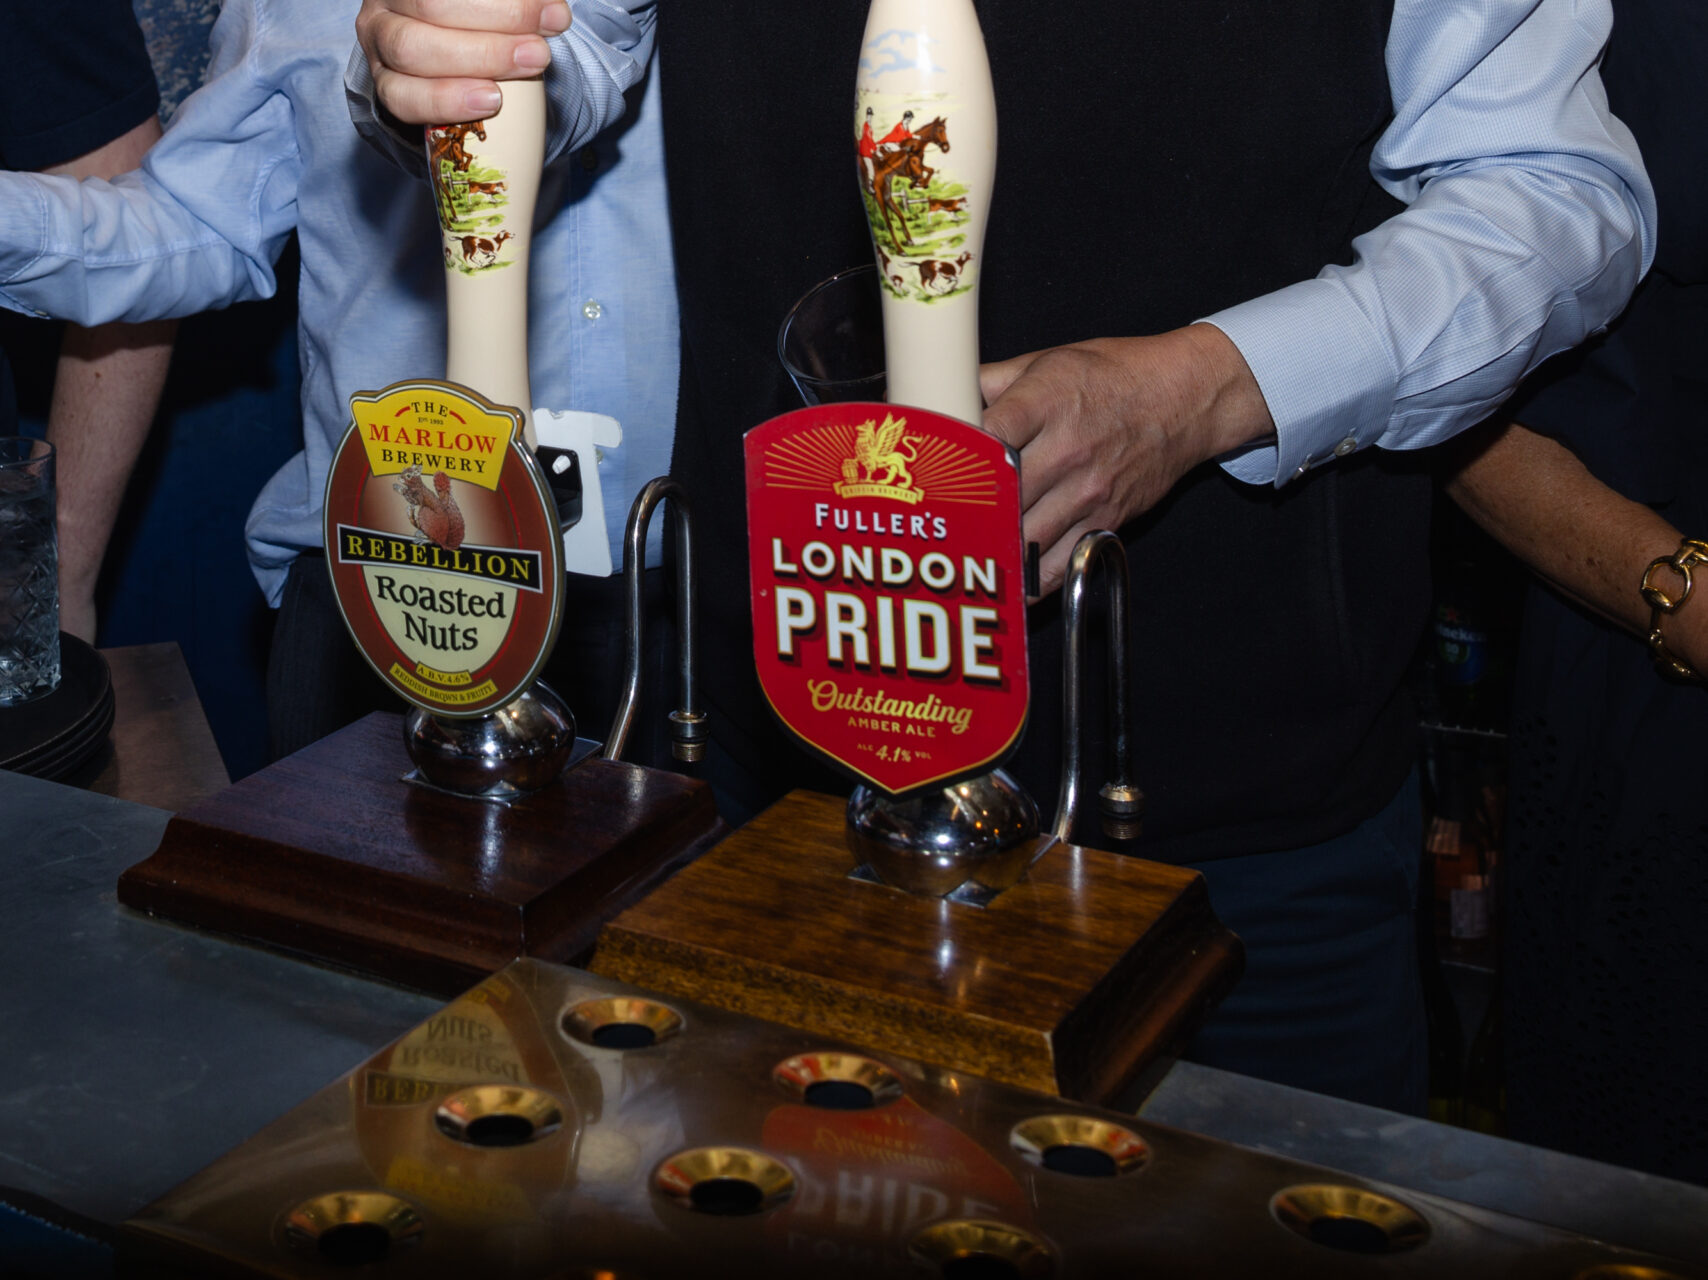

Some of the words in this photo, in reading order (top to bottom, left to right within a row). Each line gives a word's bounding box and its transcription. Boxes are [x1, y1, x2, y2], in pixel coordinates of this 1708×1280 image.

[411, 401, 449, 418] THE
[369, 423, 497, 455] MARLOW
[382, 449, 487, 474] BREWERY
[347, 535, 531, 581] REBELLION
[771, 538, 998, 594] LONDON
[375, 575, 507, 619] Roasted
[402, 612, 479, 652] Nuts
[774, 586, 1003, 681] PRIDE
[394, 667, 428, 696] REDDISH
[429, 690, 458, 702] BROWN
[467, 685, 493, 700] FRUITY
[807, 678, 973, 736] Outstanding
[847, 716, 901, 733] AMBER
[905, 723, 937, 738] ALE
[876, 744, 911, 762] 4.1%
